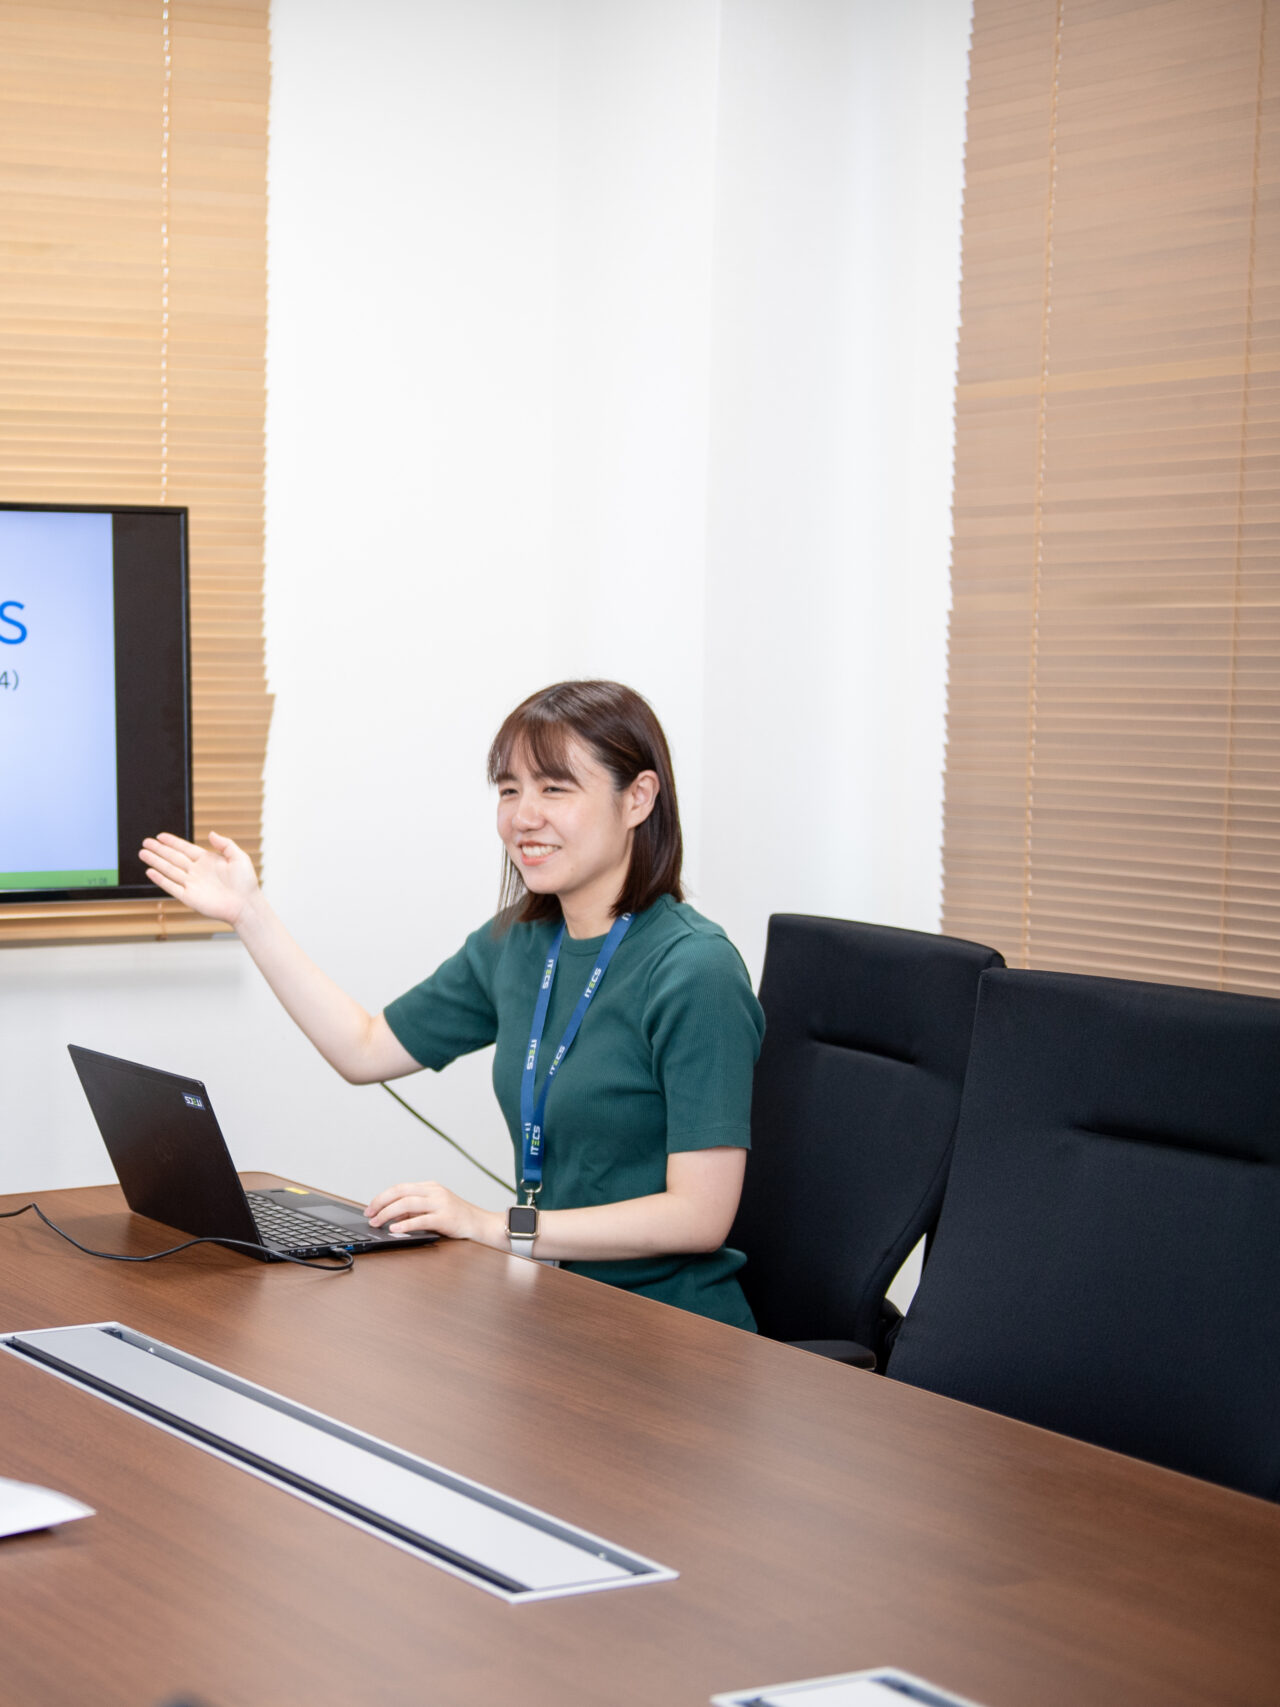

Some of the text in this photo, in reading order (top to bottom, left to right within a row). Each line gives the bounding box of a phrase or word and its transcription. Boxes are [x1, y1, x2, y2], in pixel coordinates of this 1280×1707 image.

[542, 958, 554, 990] ITECS
[584, 967, 602, 999] ITECS
[526, 1038, 538, 1071] ITECS
[548, 1045, 565, 1075] ITECS
[530, 1125, 541, 1156] ITECS
